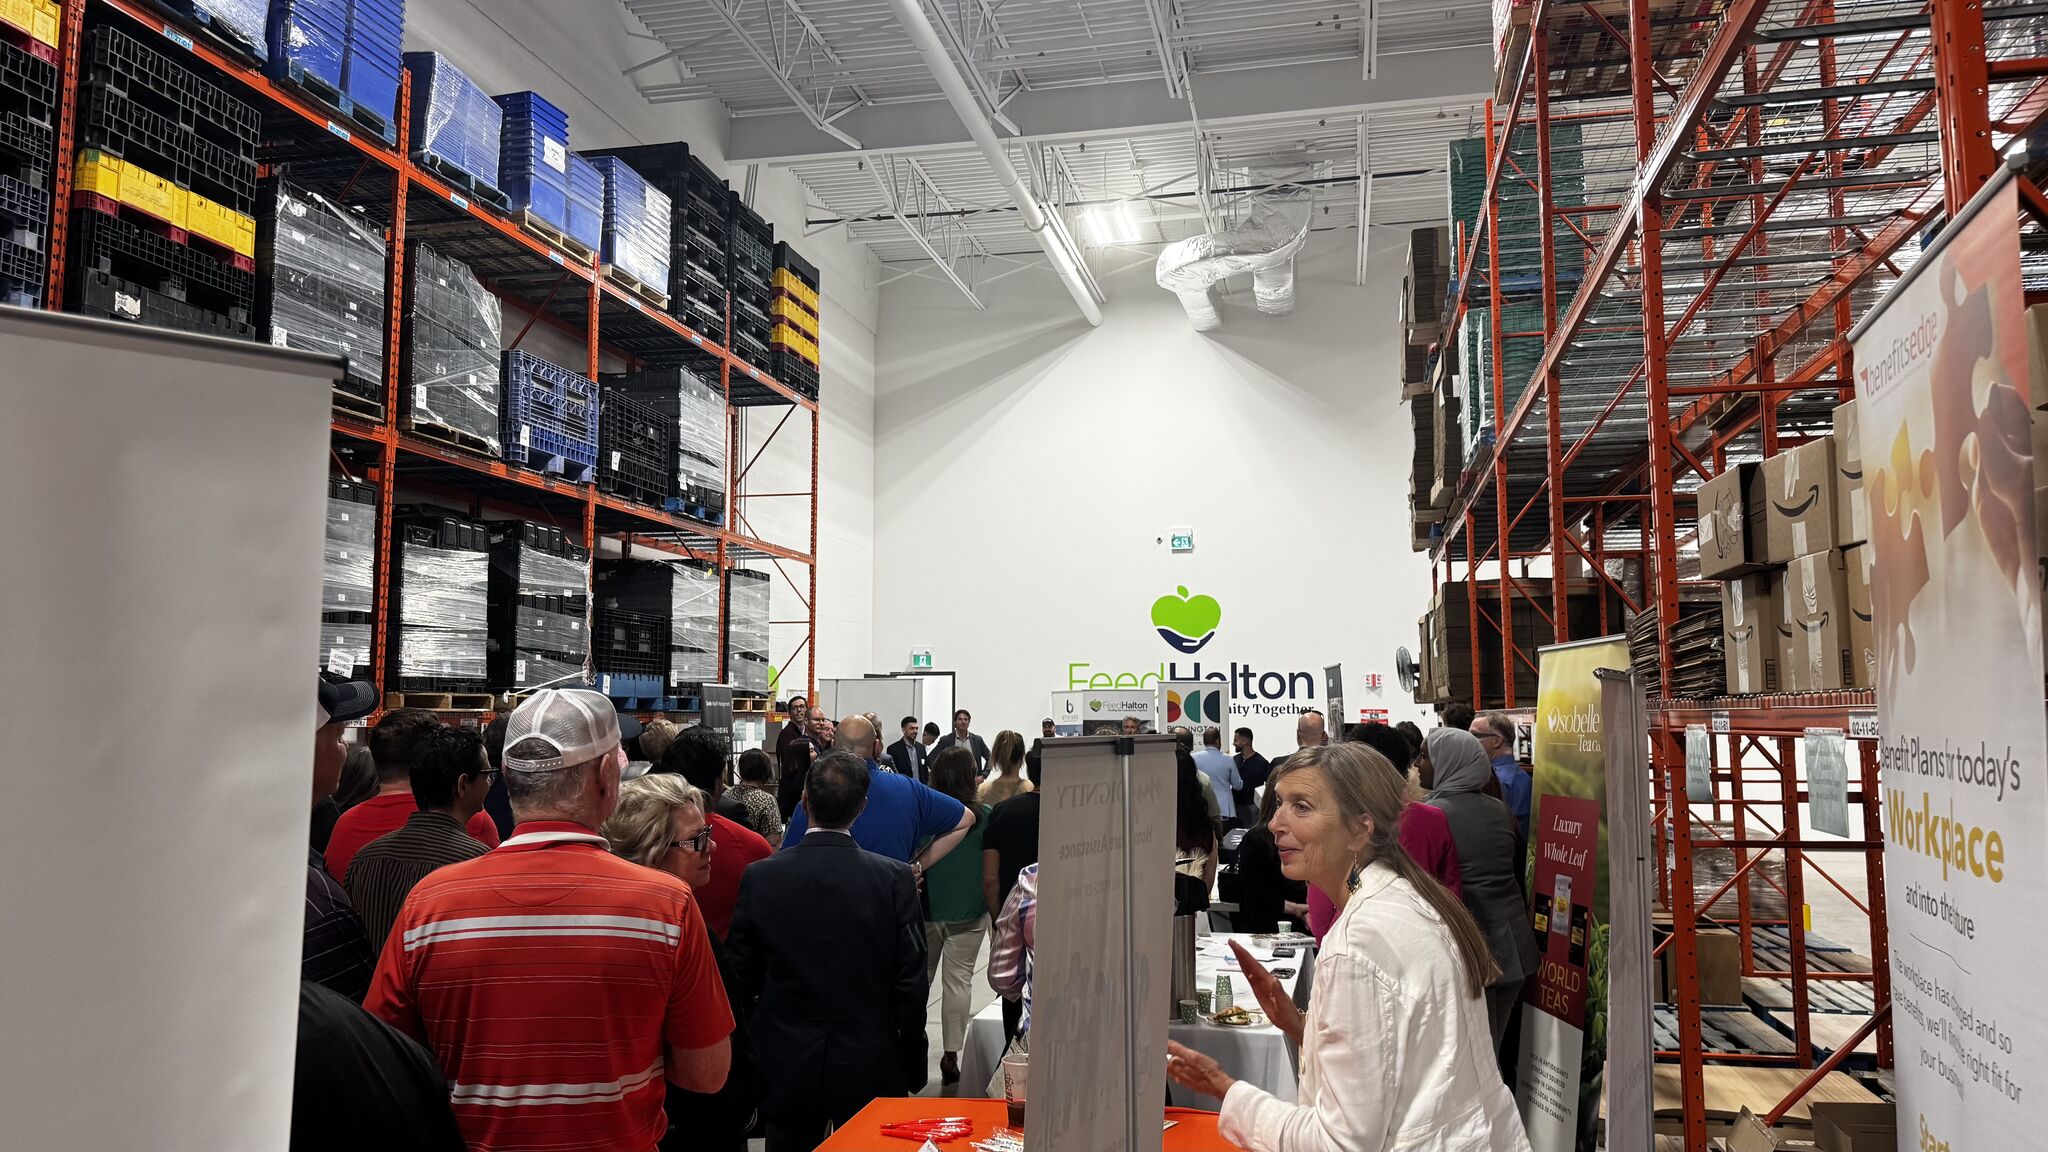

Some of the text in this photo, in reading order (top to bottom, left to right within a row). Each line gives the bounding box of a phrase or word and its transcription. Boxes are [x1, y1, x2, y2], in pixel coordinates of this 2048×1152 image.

[1578, 735, 1592, 752] Tea
[1852, 721, 1879, 736] 02-11-B2
[1910, 736, 1945, 778] Plans
[1957, 740, 2021, 802] today's
[1553, 814, 1582, 839] Luxury
[1544, 842, 1588, 872] Whole Leaf
[1905, 881, 1919, 909] and
[1919, 884, 1939, 917] into
[1540, 984, 1569, 1016] TEAS
[1935, 977, 1951, 1008] has
[1975, 1019, 1996, 1046] and
[1999, 1031, 2013, 1055] so
[1926, 1016, 1947, 1042] we'll
[1966, 1048, 1990, 1083] right
[1991, 1061, 2004, 1093] fit
[2004, 1070, 2023, 1105] for
